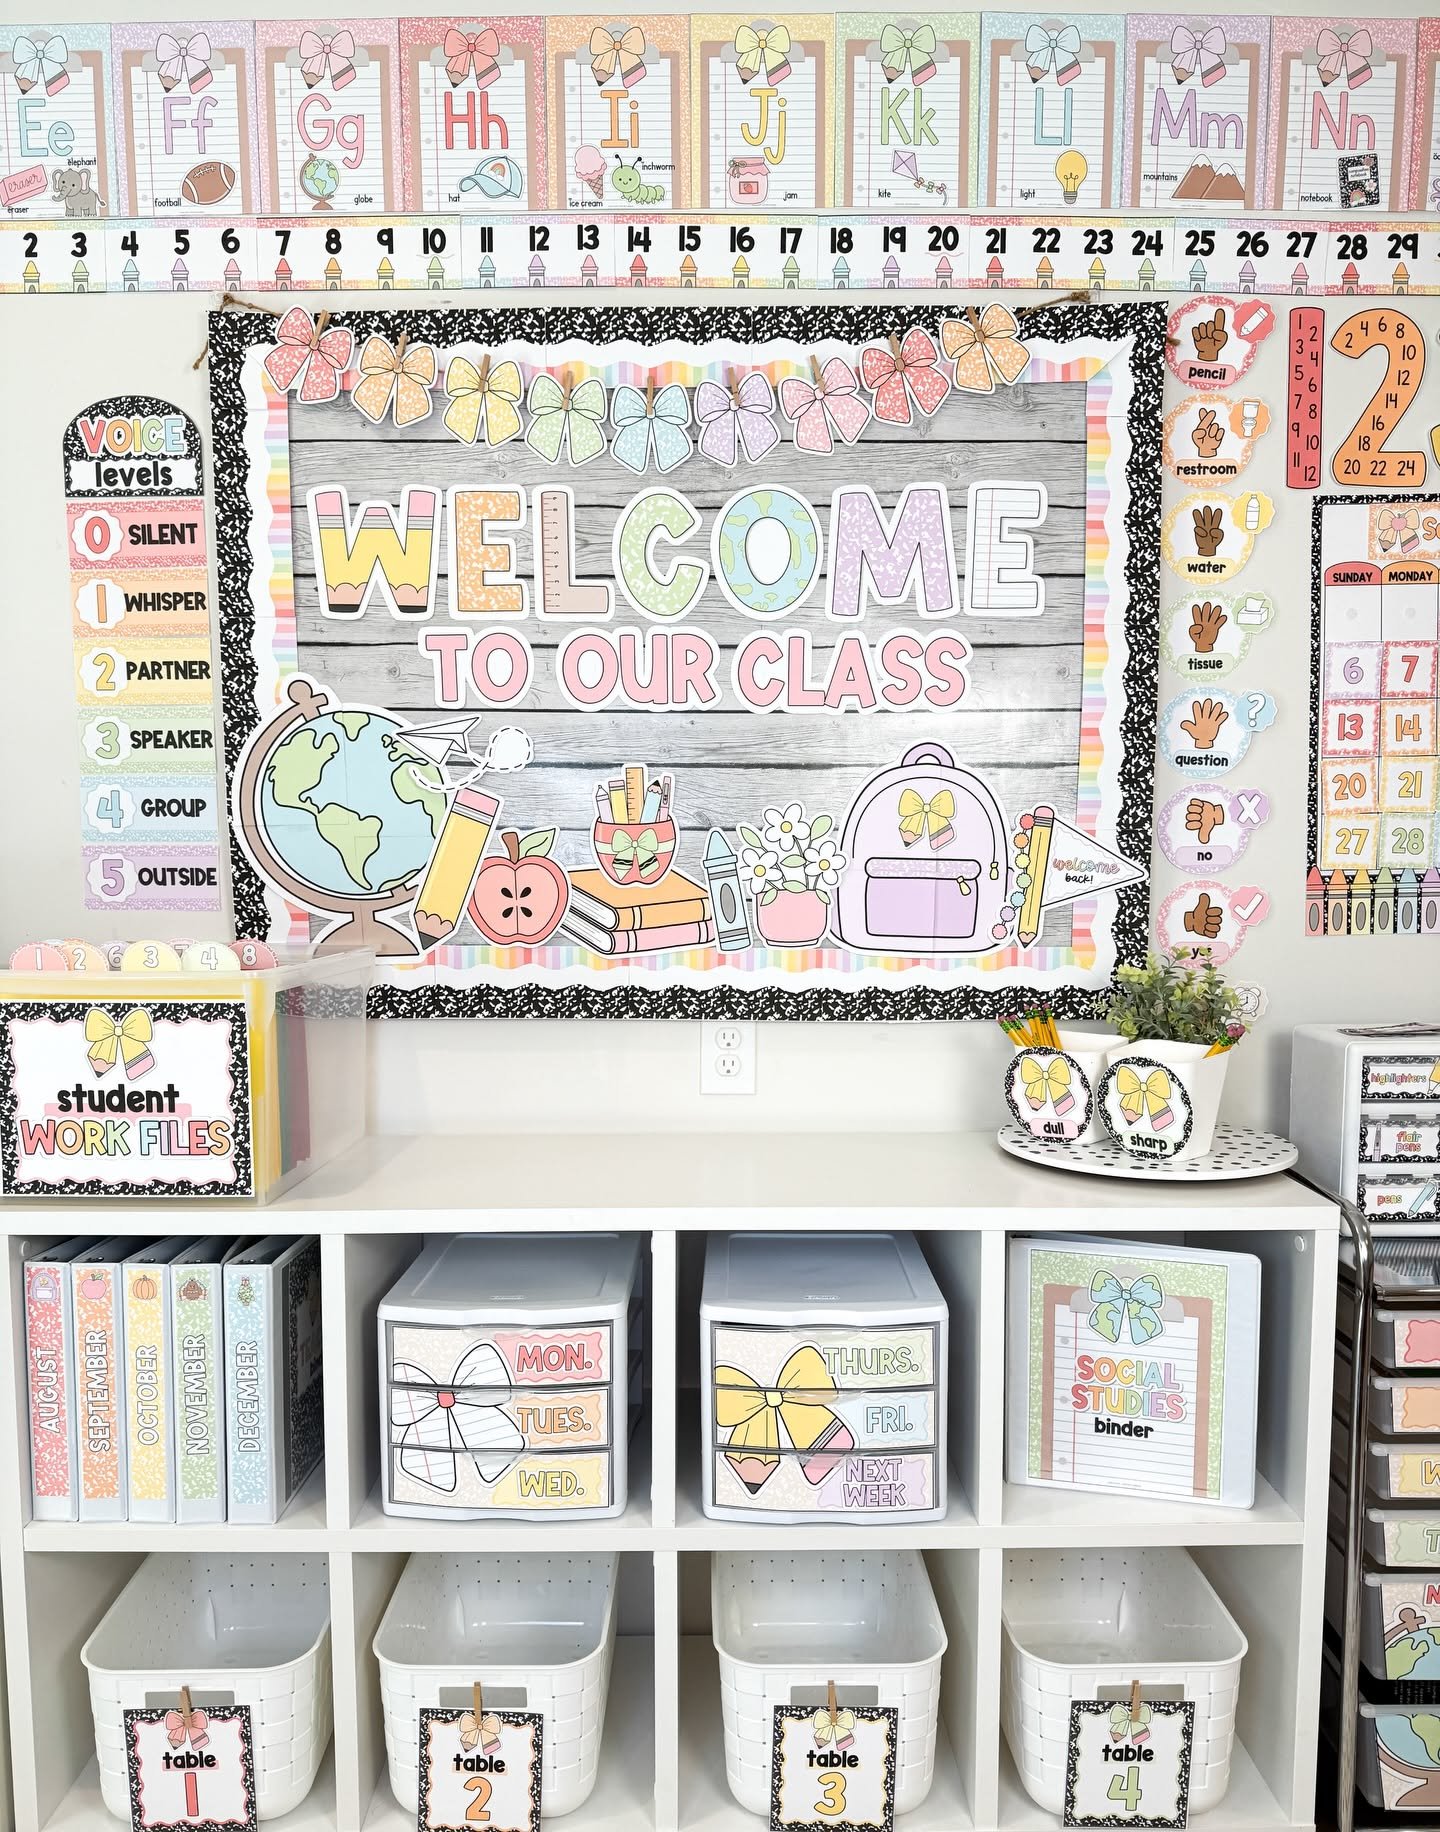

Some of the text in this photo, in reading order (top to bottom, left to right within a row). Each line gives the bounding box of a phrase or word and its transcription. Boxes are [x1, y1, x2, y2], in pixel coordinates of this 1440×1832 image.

[18, 98, 75, 157] Ee
[163, 96, 218, 155] Ff
[444, 91, 509, 149] Hh
[600, 90, 639, 148] Ii
[741, 88, 786, 165] Jj
[881, 87, 939, 146] Kk
[1035, 88, 1073, 146] Ll
[1151, 88, 1244, 149] Mm
[1311, 91, 1375, 150] Nn
[297, 93, 364, 168] Gg
[8, 174, 43, 192] eraser
[1143, 173, 1178, 182] mountains
[154, 198, 182, 208] football
[354, 194, 373, 205] globe
[448, 193, 461, 203] hat
[581, 199, 603, 208] cream
[783, 191, 798, 202] jam
[878, 189, 892, 199] kite
[1019, 189, 1036, 200] light
[1301, 193, 1333, 203] notebook
[23, 225, 1419, 260] 2 3 4 5 6 7 8 9 10 11 12 13 14 15 16 17 18 19 20 21 22 23 24 25 26 27 28 29
[1298, 313, 1302, 330] 1
[1345, 316, 1405, 348] 2 4 6 8
[1309, 326, 1318, 341] 2
[1296, 339, 1304, 354] 3
[1402, 345, 1416, 360] 10
[1310, 351, 1318, 367] 4
[1188, 366, 1227, 381] pencil
[1295, 365, 1304, 380] 5
[1397, 370, 1410, 385] 12
[1308, 377, 1317, 392] 6
[1294, 393, 1303, 410] 7
[1309, 404, 1317, 419] 8
[1386, 393, 1398, 408] 14
[1292, 422, 1300, 438] 9
[1372, 415, 1385, 430] 16
[80, 418, 185, 454] VOICE
[1306, 434, 1320, 450] 10
[1358, 435, 1370, 451] 18
[1177, 462, 1237, 477] restroom
[1293, 452, 1300, 468] 11
[1343, 459, 1415, 476] 20 22 24
[95, 460, 173, 488] levels
[1304, 466, 1317, 482] 12
[84, 516, 198, 554] 0 SILENT
[314, 488, 1041, 616] WELCOME
[1187, 561, 1227, 574] water
[1333, 571, 1433, 583] SUNDAY MONDAY
[124, 591, 207, 613] WHISPER
[93, 652, 211, 691] 2 PARTNER
[425, 632, 967, 709] TO OUR CLASS
[1188, 657, 1223, 671] tissue
[1343, 655, 1419, 684] 6 7
[1337, 713, 1422, 741] 13 14
[95, 721, 214, 760] 3 SPEAKER
[1175, 753, 1228, 769] question
[1332, 771, 1423, 800] 20 21
[96, 789, 207, 829] 4 GROUP
[1335, 827, 1425, 855] 27 28
[1053, 857, 1120, 875] welcome
[1197, 850, 1213, 862] no
[100, 858, 218, 896] 5 OUTSIDE
[1065, 873, 1094, 884] back!
[72, 947, 87, 970] 2
[108, 945, 123, 968] 6
[143, 945, 159, 968] 3
[201, 947, 218, 970] 4
[241, 944, 257, 966] 8
[1371, 1073, 1426, 1086] highlighters
[57, 1083, 179, 1113] student
[20, 1119, 231, 1156] WORK FILES
[1043, 1121, 1064, 1135] dull
[1396, 1131, 1423, 1142] flair
[1130, 1133, 1168, 1152] sharp
[1395, 1142, 1421, 1153] pens
[1377, 1194, 1402, 1206] pens
[516, 1343, 593, 1373] MON.
[823, 1347, 919, 1375] THURS.
[1077, 1354, 1180, 1390] SOCIAL
[36, 1347, 60, 1433] AUGUST
[84, 1329, 110, 1453] SEPTEMBER
[135, 1344, 160, 1446] OCTOBER
[182, 1333, 210, 1456] NOVEMBER
[236, 1341, 261, 1453] DECEMBER
[1071, 1384, 1184, 1420] STUDIES
[517, 1406, 592, 1434] TUES.
[866, 1406, 913, 1434] FRI.
[1094, 1417, 1154, 1439] binder
[846, 1458, 902, 1483] NEXT
[519, 1470, 585, 1498] WED.
[843, 1484, 906, 1507] WEEK
[162, 1751, 217, 1770] table
[453, 1753, 506, 1773] table
[806, 1749, 860, 1768] table
[1102, 1743, 1154, 1763] table
[185, 1771, 198, 1817] 1
[463, 1776, 493, 1821] 2
[814, 1771, 847, 1816] 3
[1106, 1766, 1142, 1811] 4
